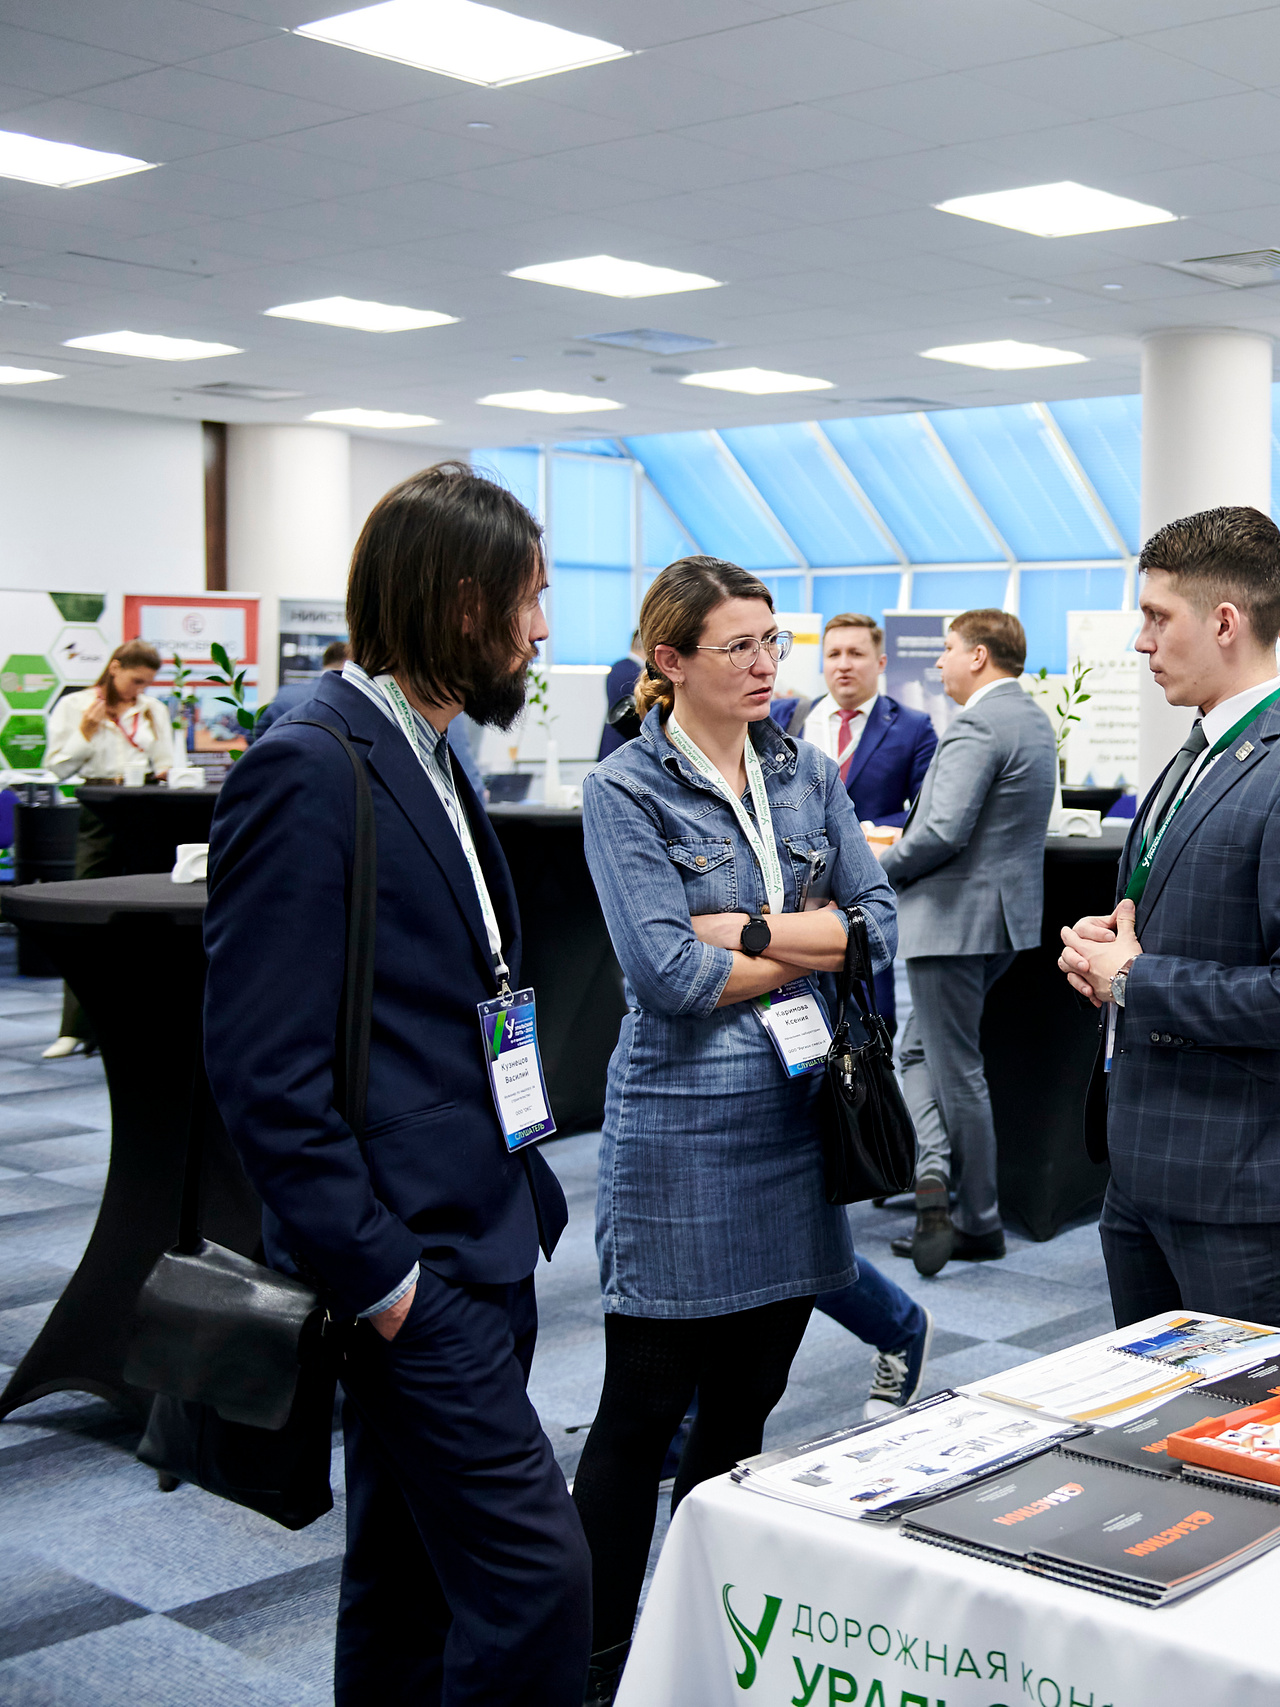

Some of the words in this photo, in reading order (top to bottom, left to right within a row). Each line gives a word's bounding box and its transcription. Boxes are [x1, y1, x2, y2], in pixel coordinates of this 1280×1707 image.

[775, 1003, 809, 1018] Каримова
[785, 1015, 809, 1026] Ксения
[501, 1056, 529, 1071] Кузнецов
[505, 1069, 530, 1084] Василий
[515, 1122, 545, 1141] СЛУШАТЕЛЬ
[993, 1489, 1071, 1527] БАСТИОН
[1123, 1521, 1201, 1558] БАСТИОН
[792, 1602, 1009, 1683] ДОРОЖНАЯ
